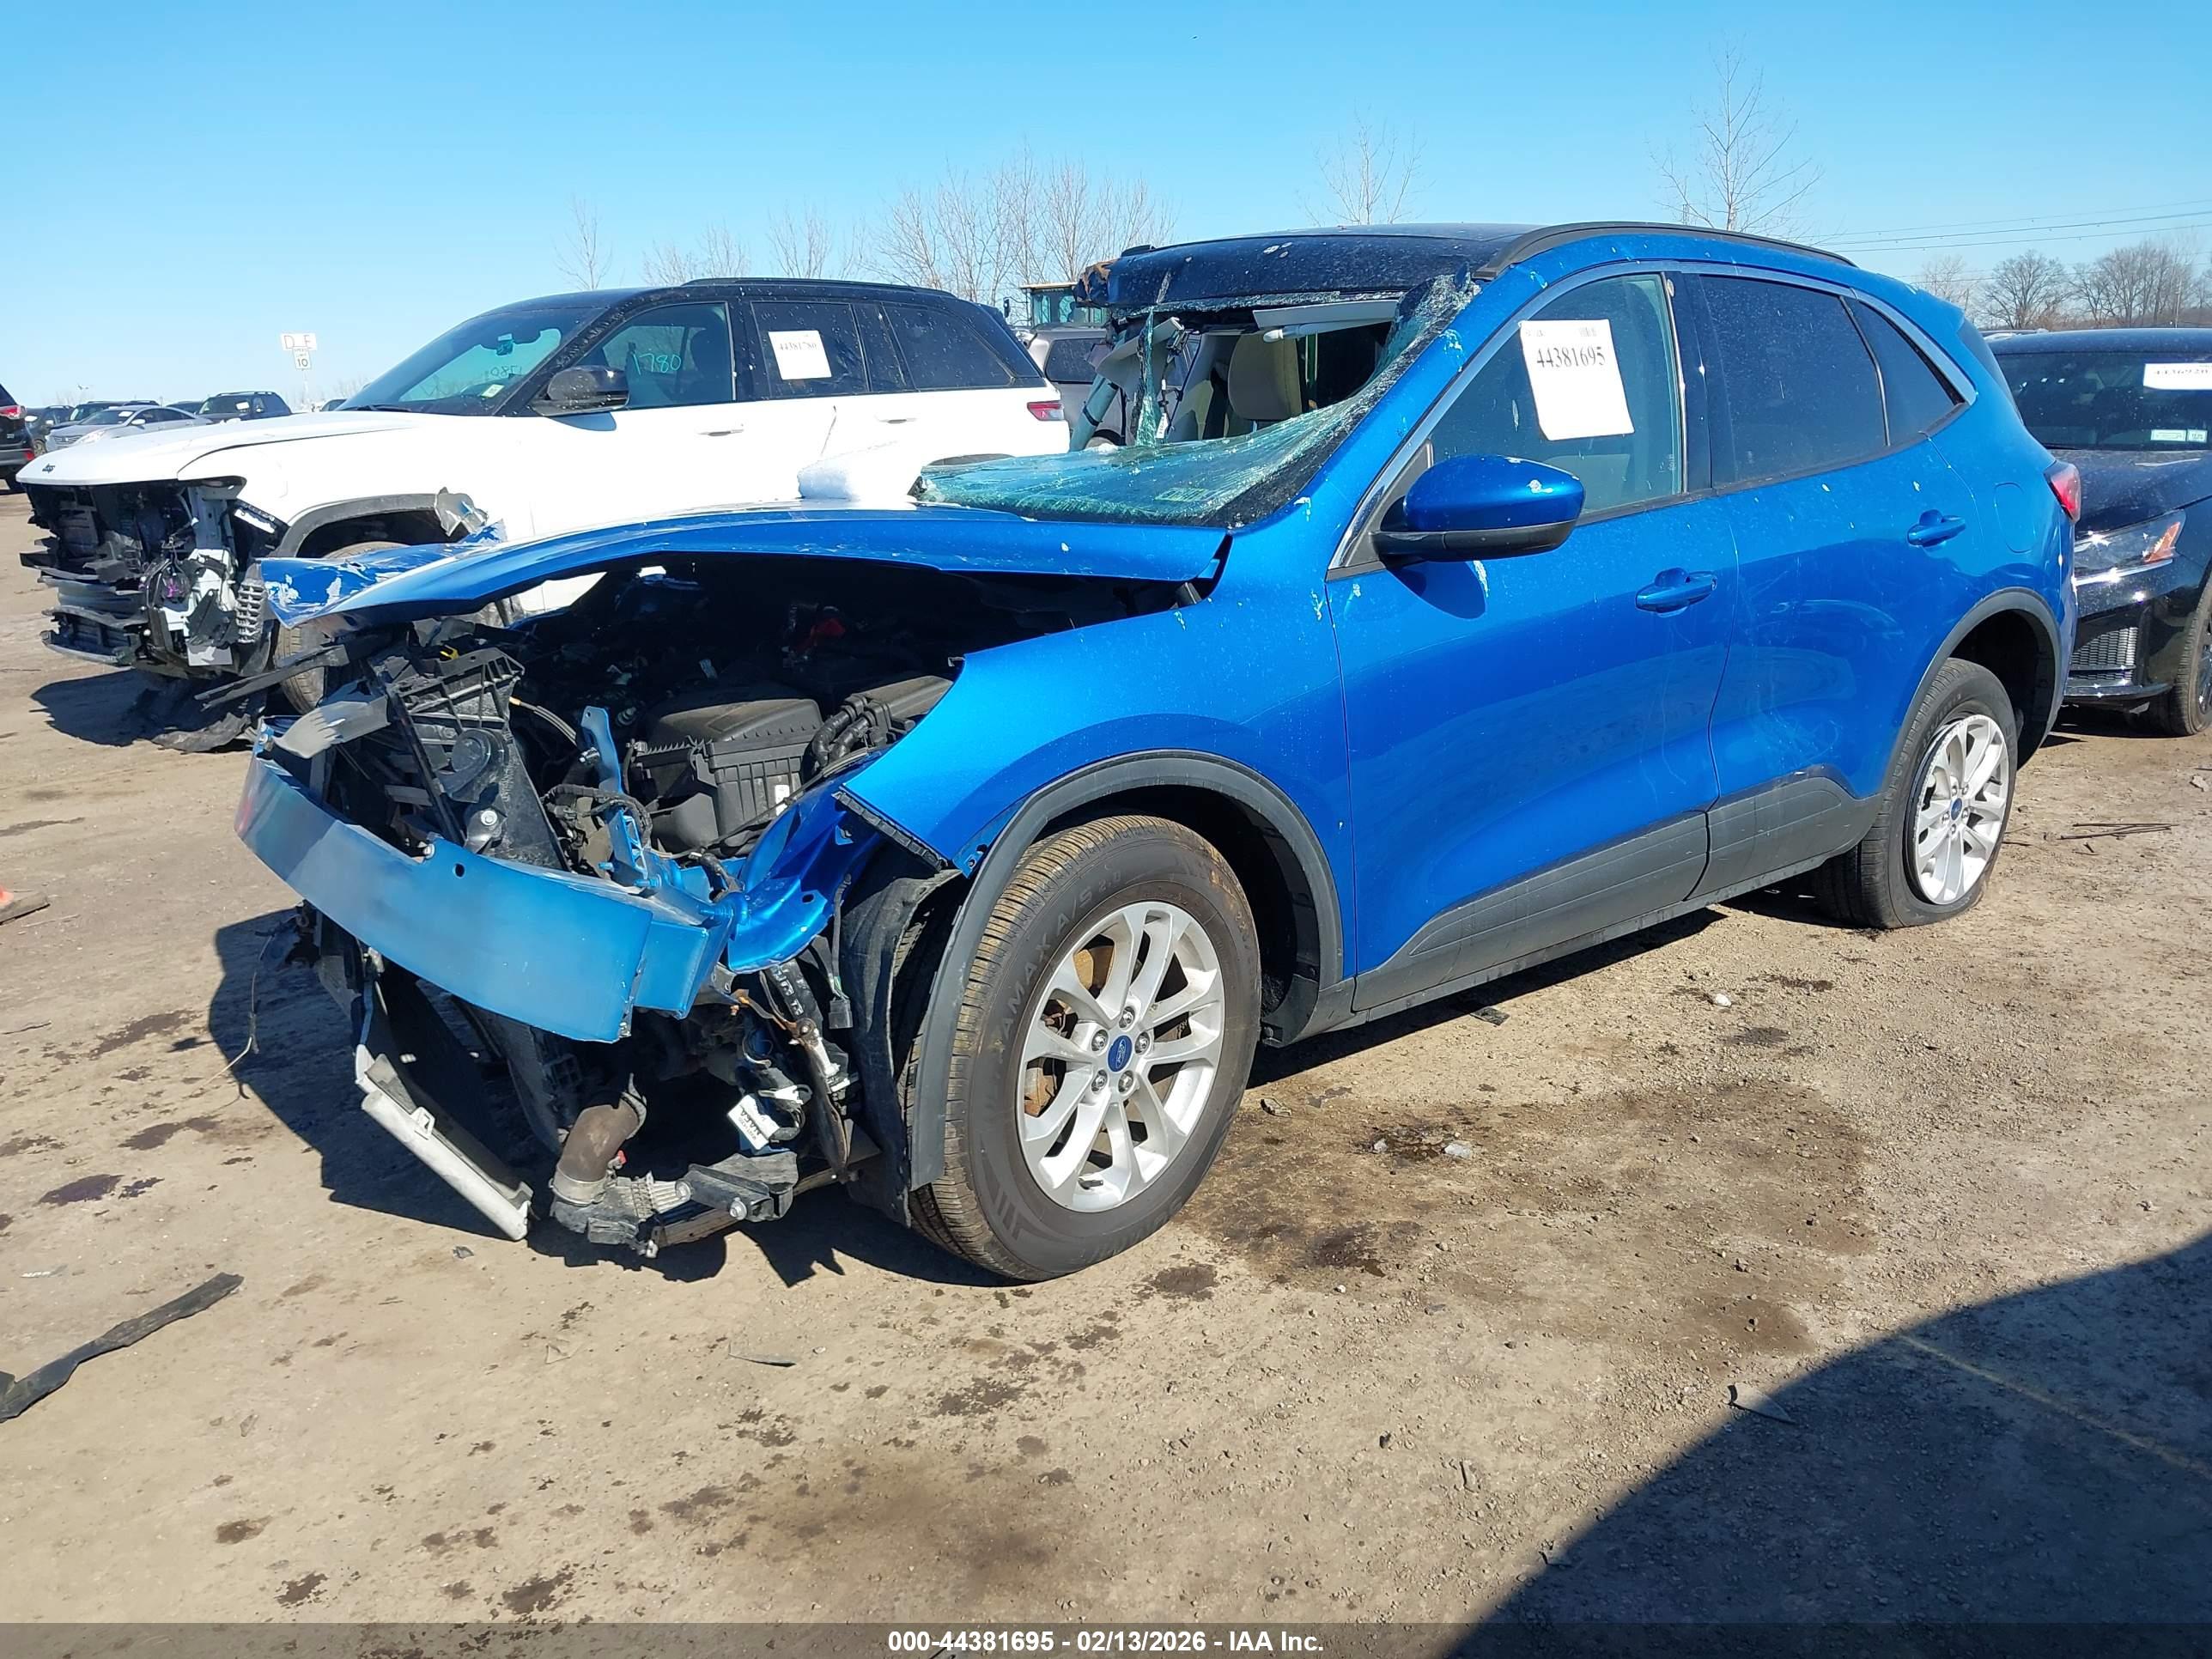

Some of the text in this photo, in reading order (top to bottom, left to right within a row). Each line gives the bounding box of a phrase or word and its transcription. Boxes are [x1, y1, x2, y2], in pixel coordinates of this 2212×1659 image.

[297, 358, 308, 368] 10
[631, 353, 681, 375] 1780
[1536, 346, 1606, 368] 44381695
